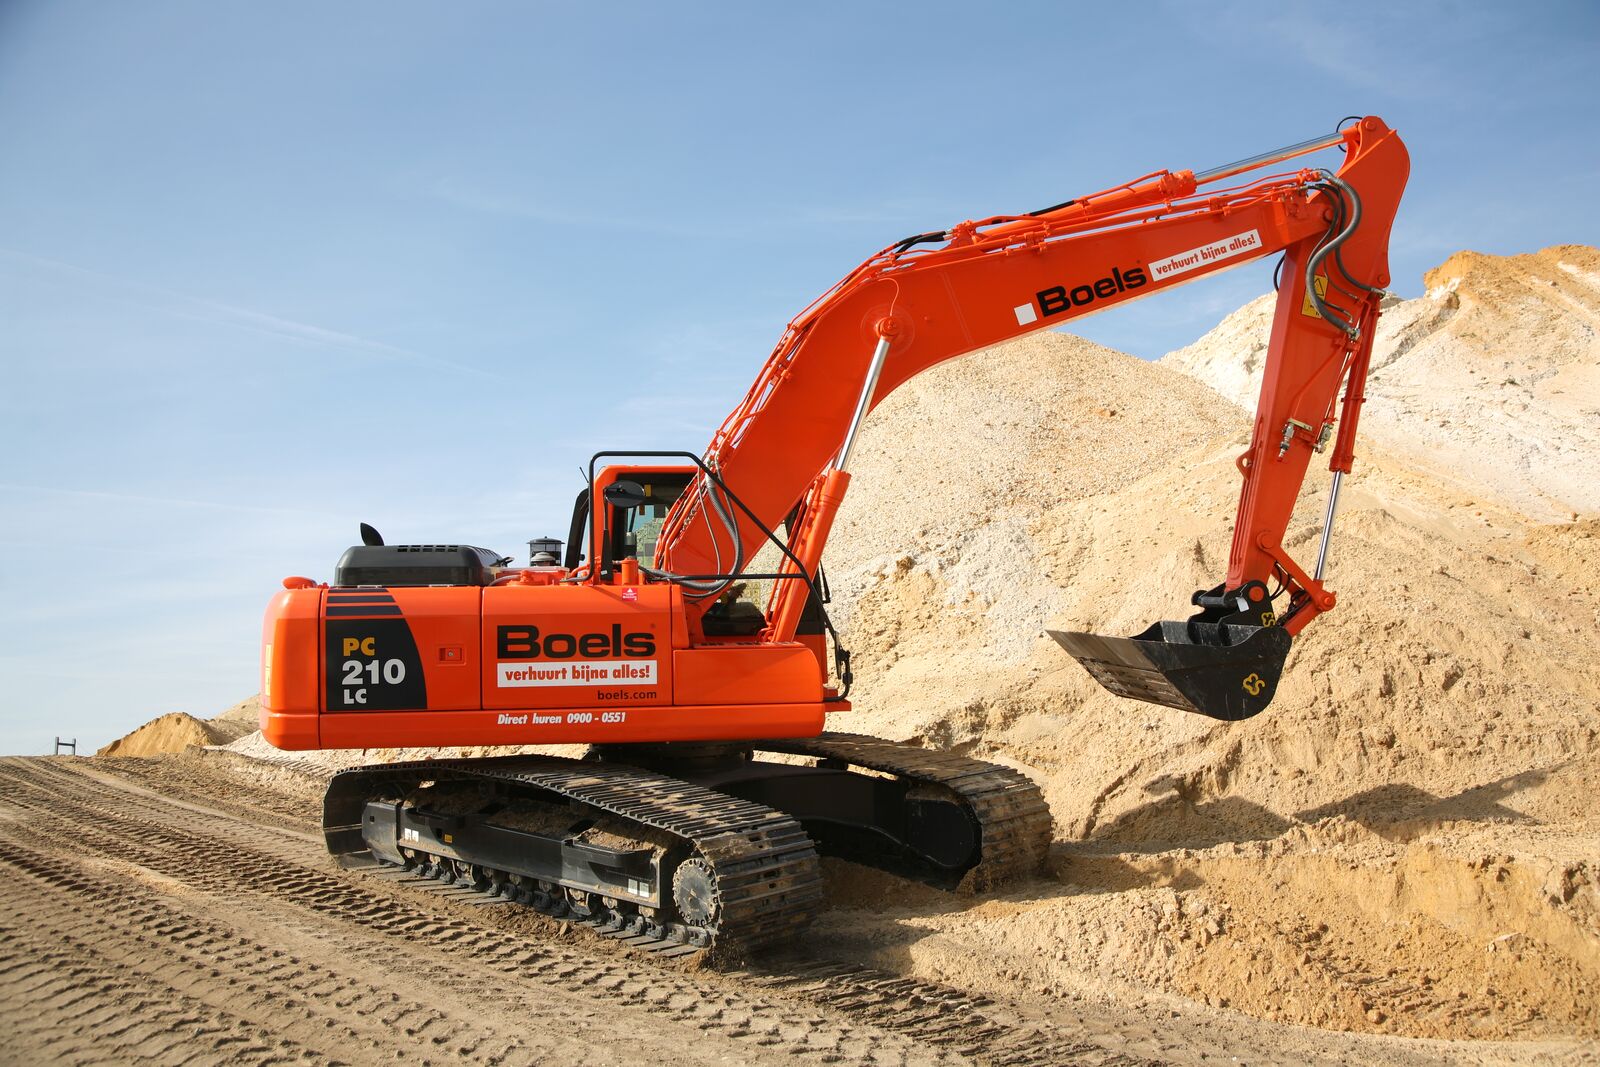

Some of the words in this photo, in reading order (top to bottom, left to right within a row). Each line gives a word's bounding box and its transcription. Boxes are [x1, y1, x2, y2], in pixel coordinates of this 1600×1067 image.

[1155, 254, 1199, 275] verhuurt
[1200, 246, 1227, 261] bijna
[1229, 234, 1256, 251] alles!
[1036, 267, 1147, 317] Boels
[343, 637, 375, 656] PC
[497, 624, 656, 659] Boels
[342, 658, 406, 685] 210
[505, 666, 567, 681] verhuurt
[571, 665, 608, 682] bijna
[612, 664, 650, 679] alles!
[343, 688, 367, 704] LC
[597, 690, 657, 700] boels.com
[497, 714, 528, 725] Direct
[532, 713, 562, 724] huren
[567, 712, 592, 723] 0900
[601, 712, 626, 723] 0551
